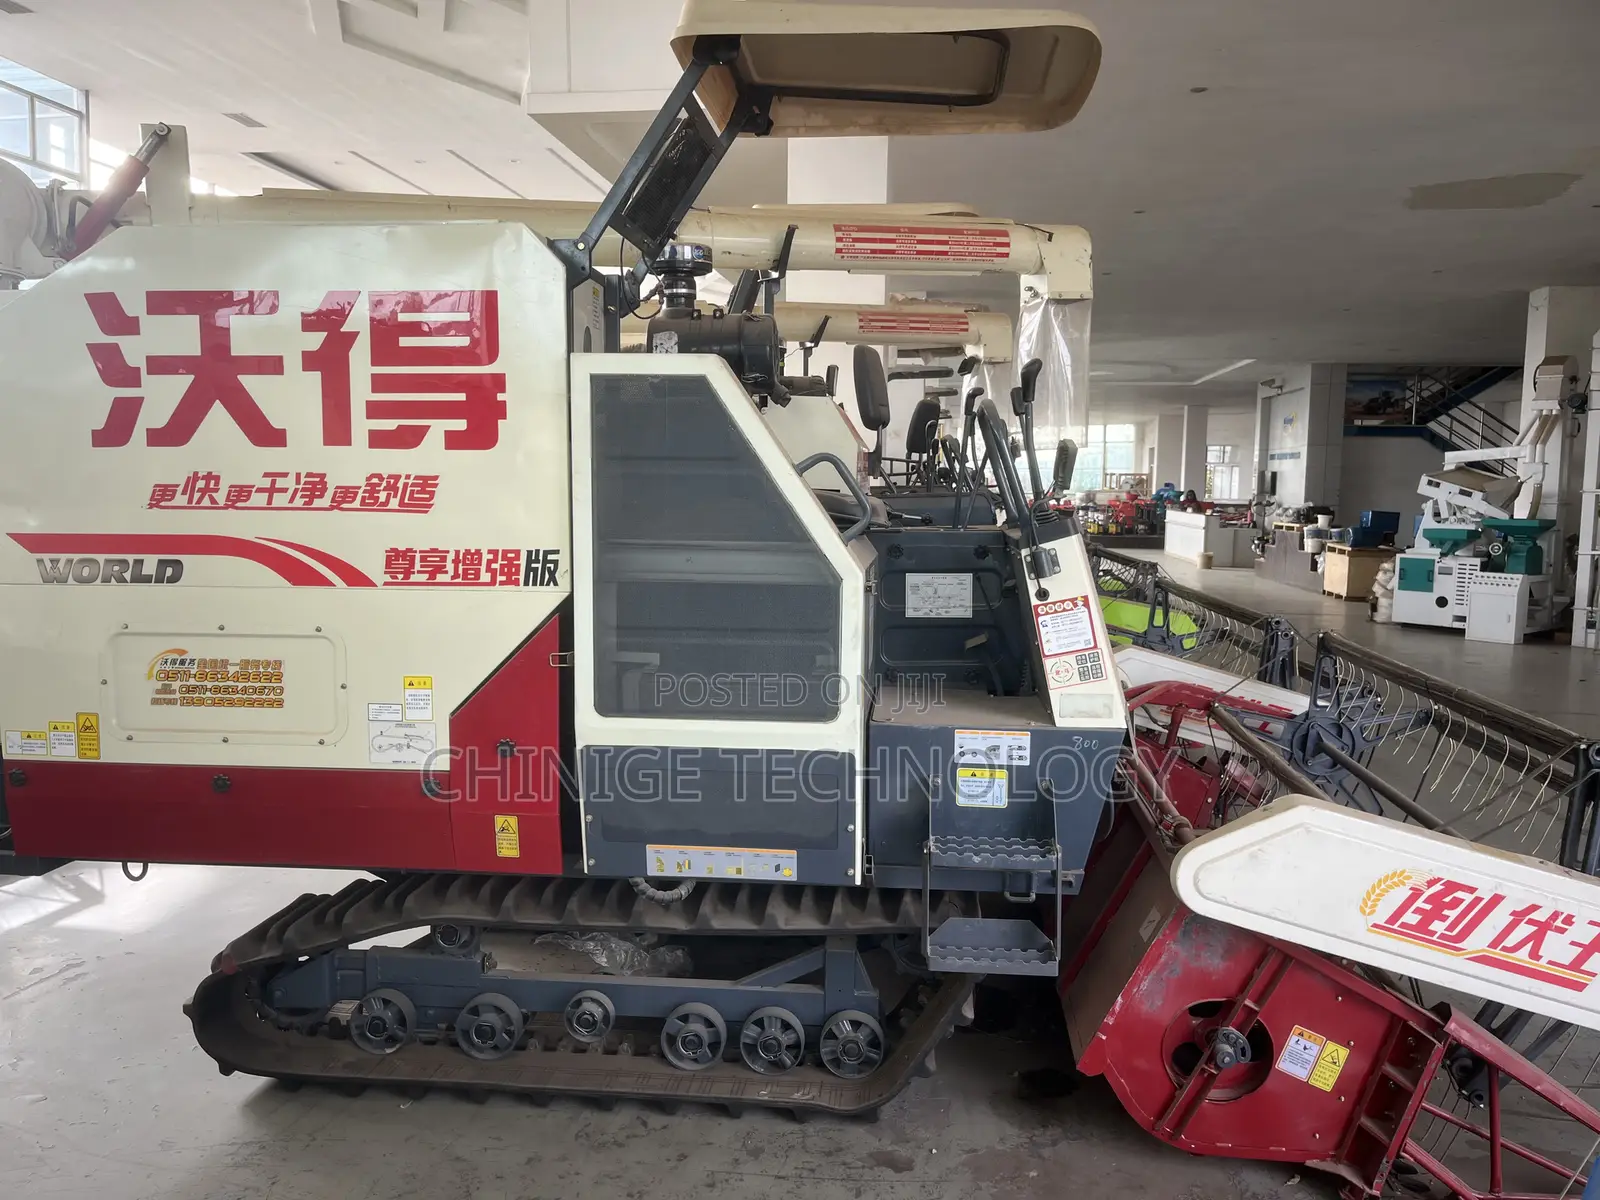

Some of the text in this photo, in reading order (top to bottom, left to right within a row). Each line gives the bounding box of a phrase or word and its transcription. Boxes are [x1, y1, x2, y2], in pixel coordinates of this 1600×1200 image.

[84, 290, 507, 450] 沃得
[147, 471, 440, 513] 更快更干净更舒适
[35, 557, 184, 584] WORLD
[383, 547, 561, 587] 尊享增强版
[156, 670, 284, 683] 0511-86342622
[179, 684, 284, 697] 0511-86340670
[179, 696, 284, 708] 13905292222
[1072, 735, 1099, 751] 800
[1384, 876, 1600, 978] 倒伏王
